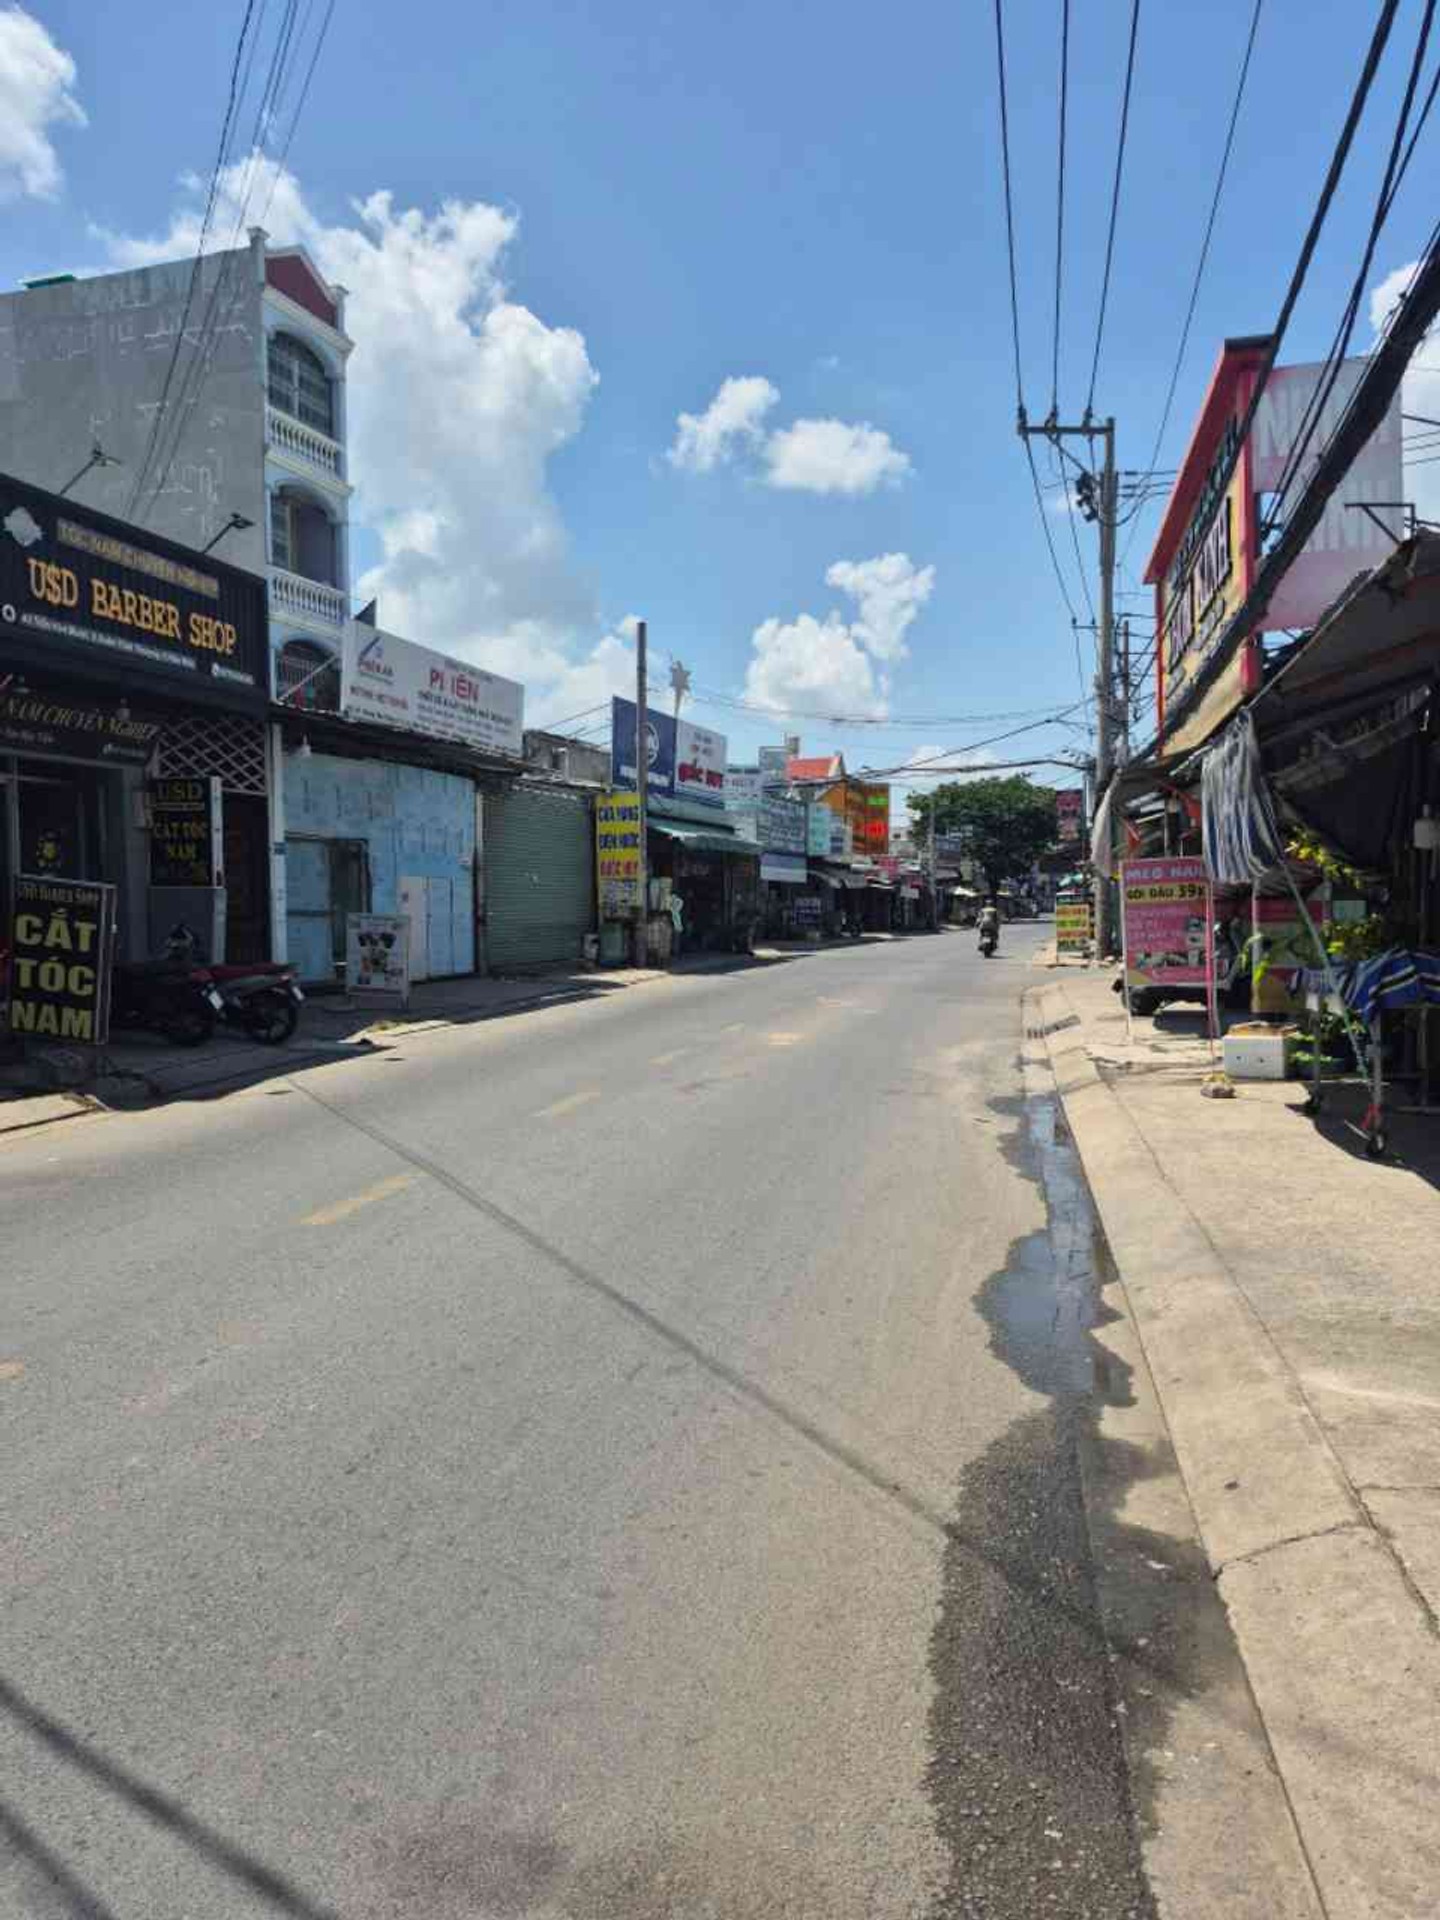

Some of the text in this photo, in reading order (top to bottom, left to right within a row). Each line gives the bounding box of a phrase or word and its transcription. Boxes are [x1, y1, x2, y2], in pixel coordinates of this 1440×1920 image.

[91, 579, 181, 638] BARBER
[189, 613, 236, 656] SHOP
[15, 908, 97, 954] CẮT
[14, 956, 96, 997] TÓC
[11, 999, 93, 1040] NAM
